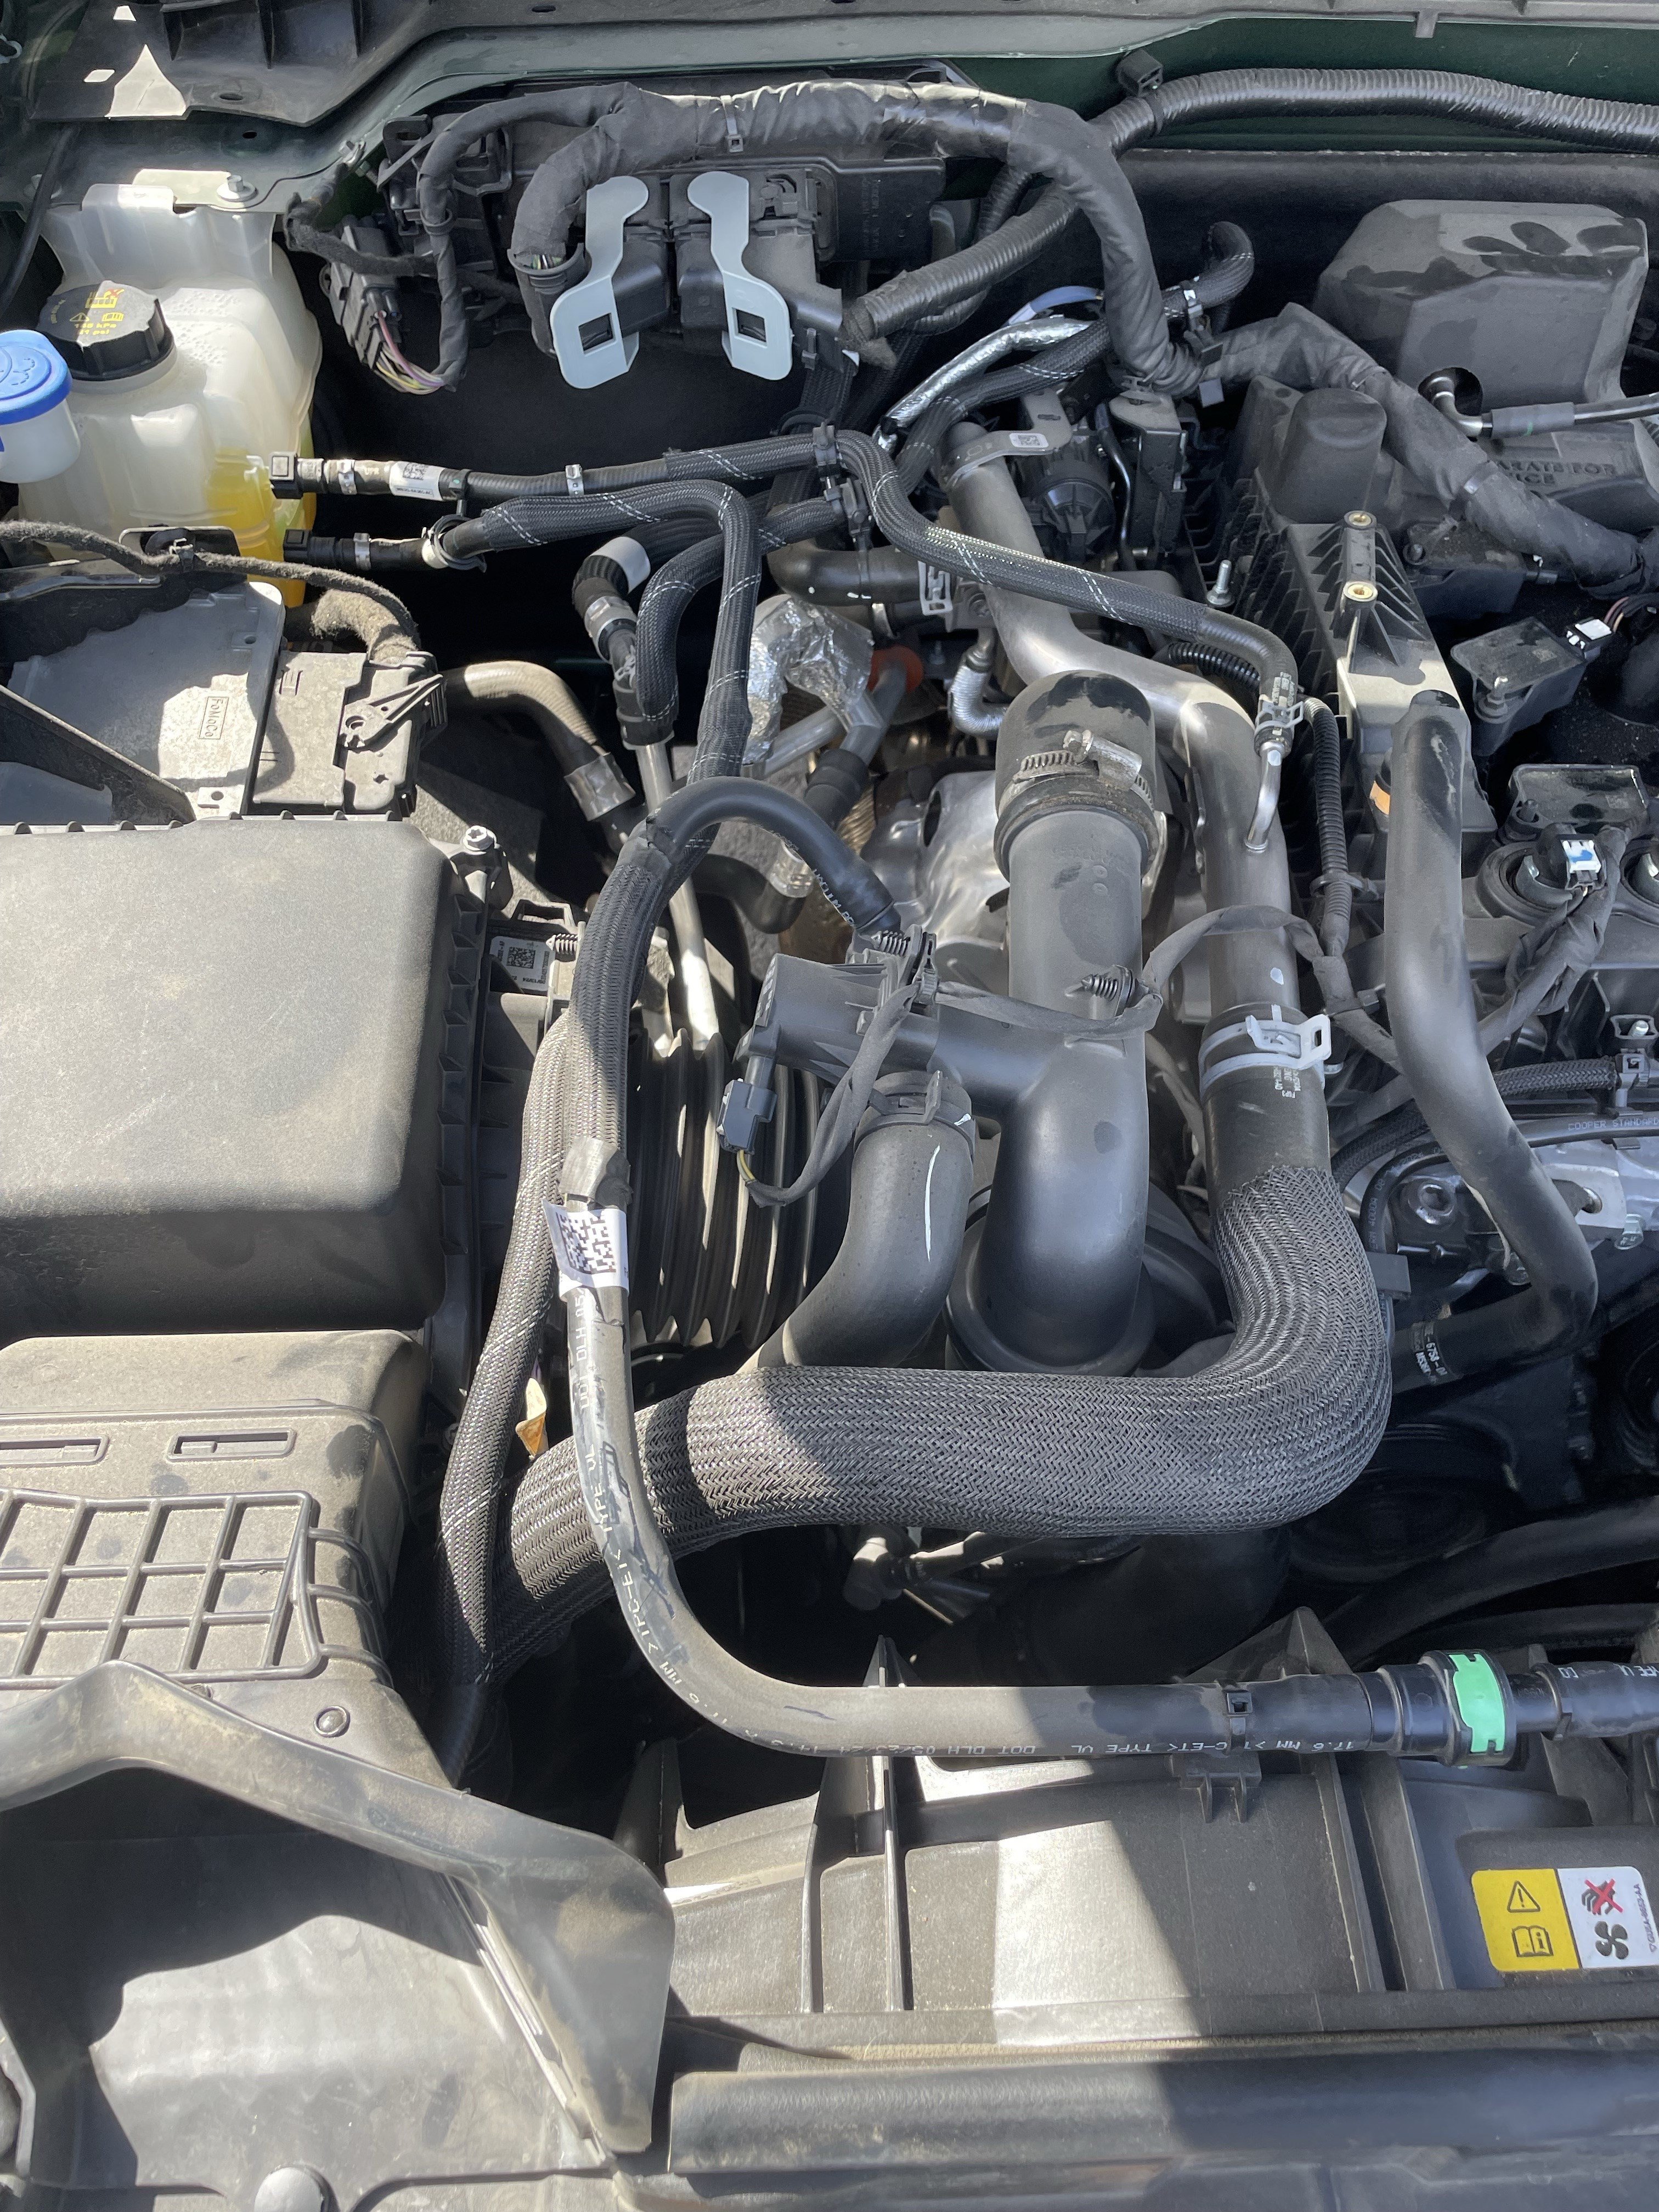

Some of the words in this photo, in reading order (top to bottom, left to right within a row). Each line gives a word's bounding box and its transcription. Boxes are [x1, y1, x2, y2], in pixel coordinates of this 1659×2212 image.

[364, 467, 380, 476] UPR
[205, 698, 223, 737] FoMoCo
[1568, 1120, 1606, 1131] COOPER
[1612, 1116, 1659, 1128] STANDARD
[575, 1325, 588, 1362] DLH
[584, 1443, 597, 1471] VL
[947, 1745, 986, 1755] DLH
[1071, 1745, 1094, 1754] VL
[1105, 1743, 1152, 1754] TYPE
[1276, 1739, 1301, 1751] MM
[1312, 1741, 1355, 1752] 17.6
